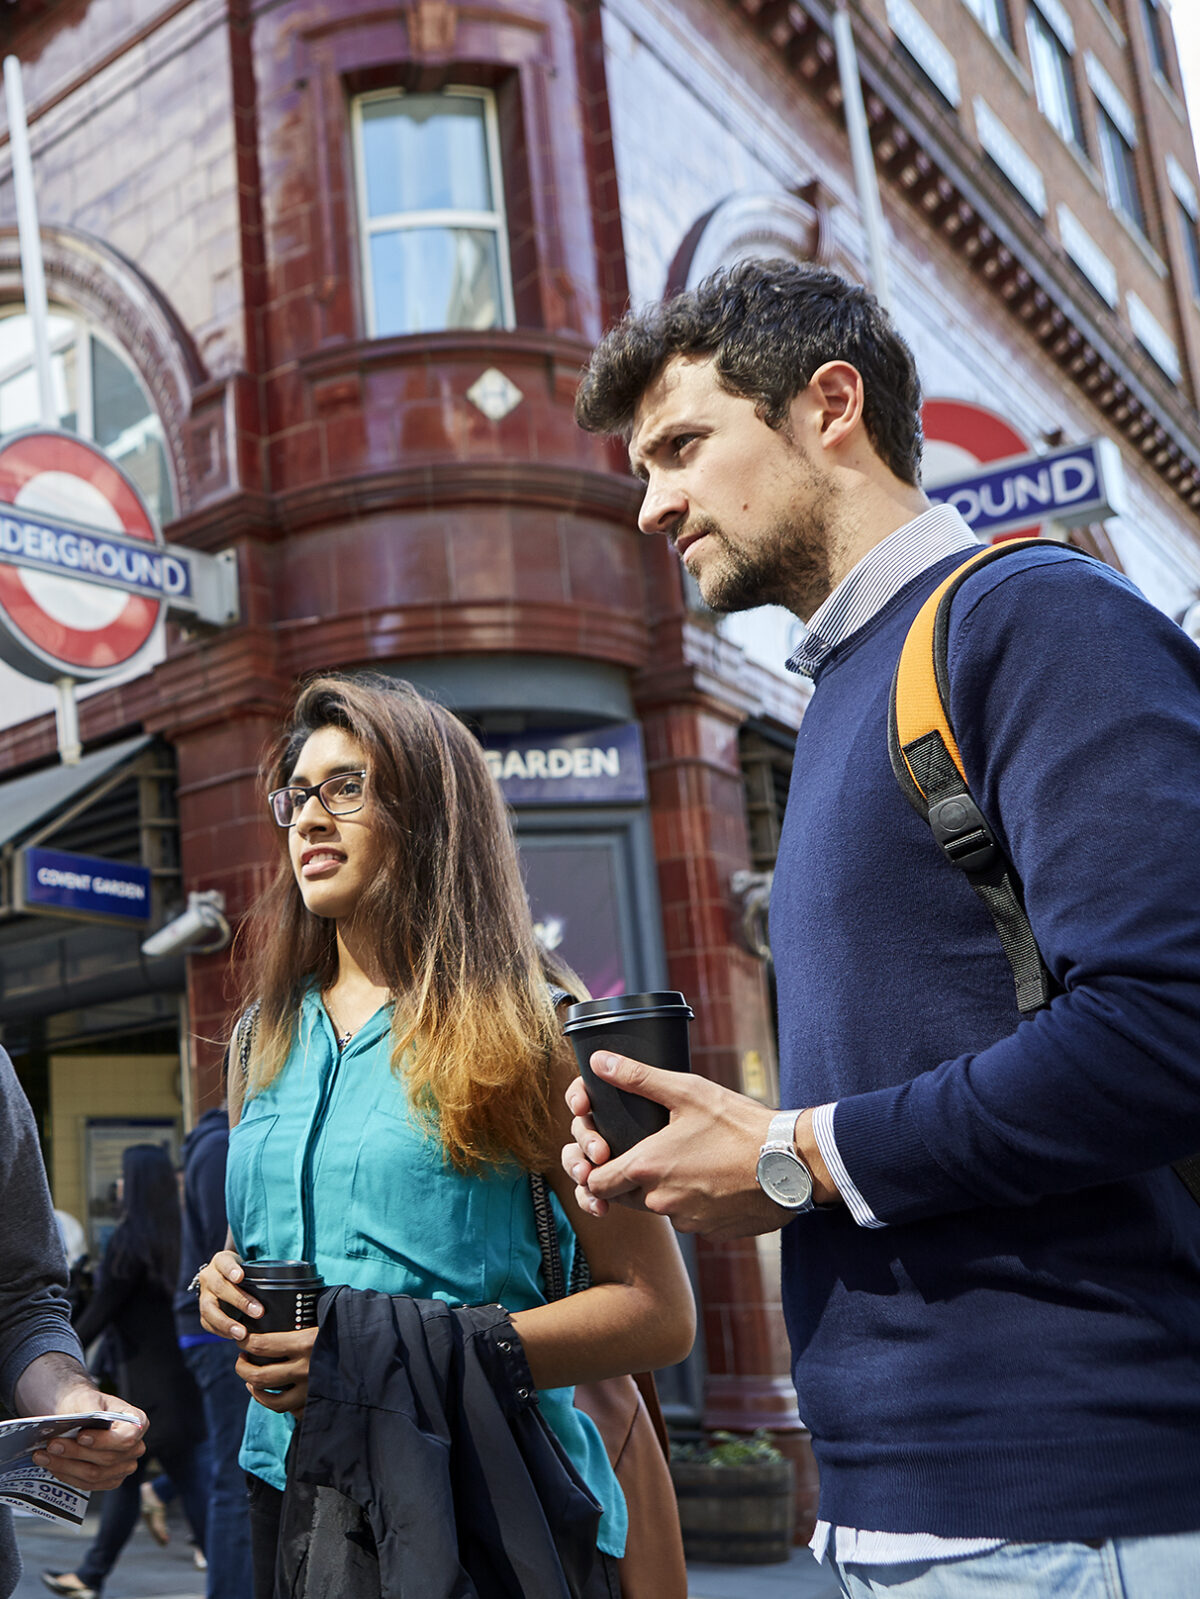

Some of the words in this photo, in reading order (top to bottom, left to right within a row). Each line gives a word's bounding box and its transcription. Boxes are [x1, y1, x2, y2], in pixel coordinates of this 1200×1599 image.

[930, 456, 1095, 524] OUND
[484, 747, 620, 779] GARDEN
[37, 867, 91, 891] COVENT
[92, 876, 146, 900] GARDEN
[38, 1492, 77, 1513] Children
[39, 1484, 79, 1506] OUT!
[31, 1507, 57, 1521] GUIDE
